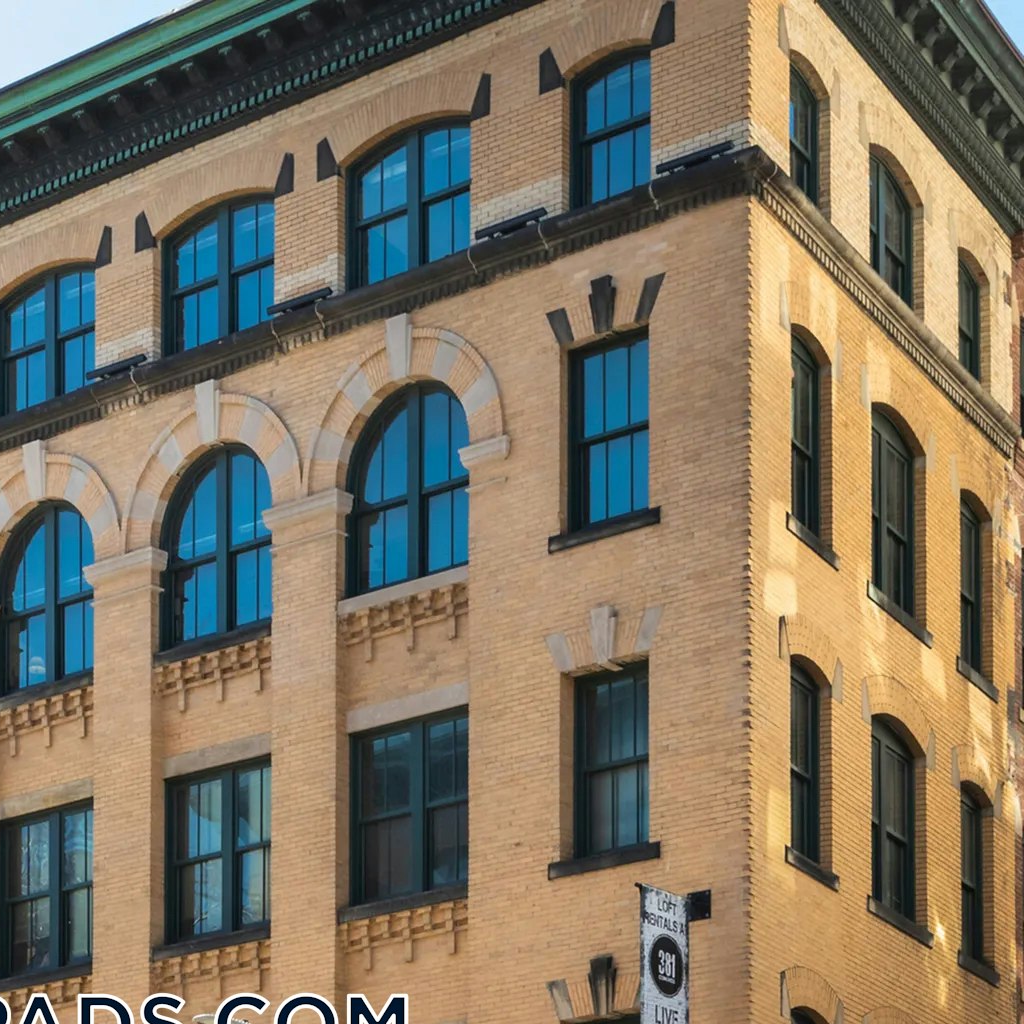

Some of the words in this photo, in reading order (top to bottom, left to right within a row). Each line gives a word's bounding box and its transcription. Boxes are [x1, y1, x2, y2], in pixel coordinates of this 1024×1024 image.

[657, 898, 676, 916] LOFT
[643, 911, 678, 933] RENTALS
[658, 949, 676, 979] 381
